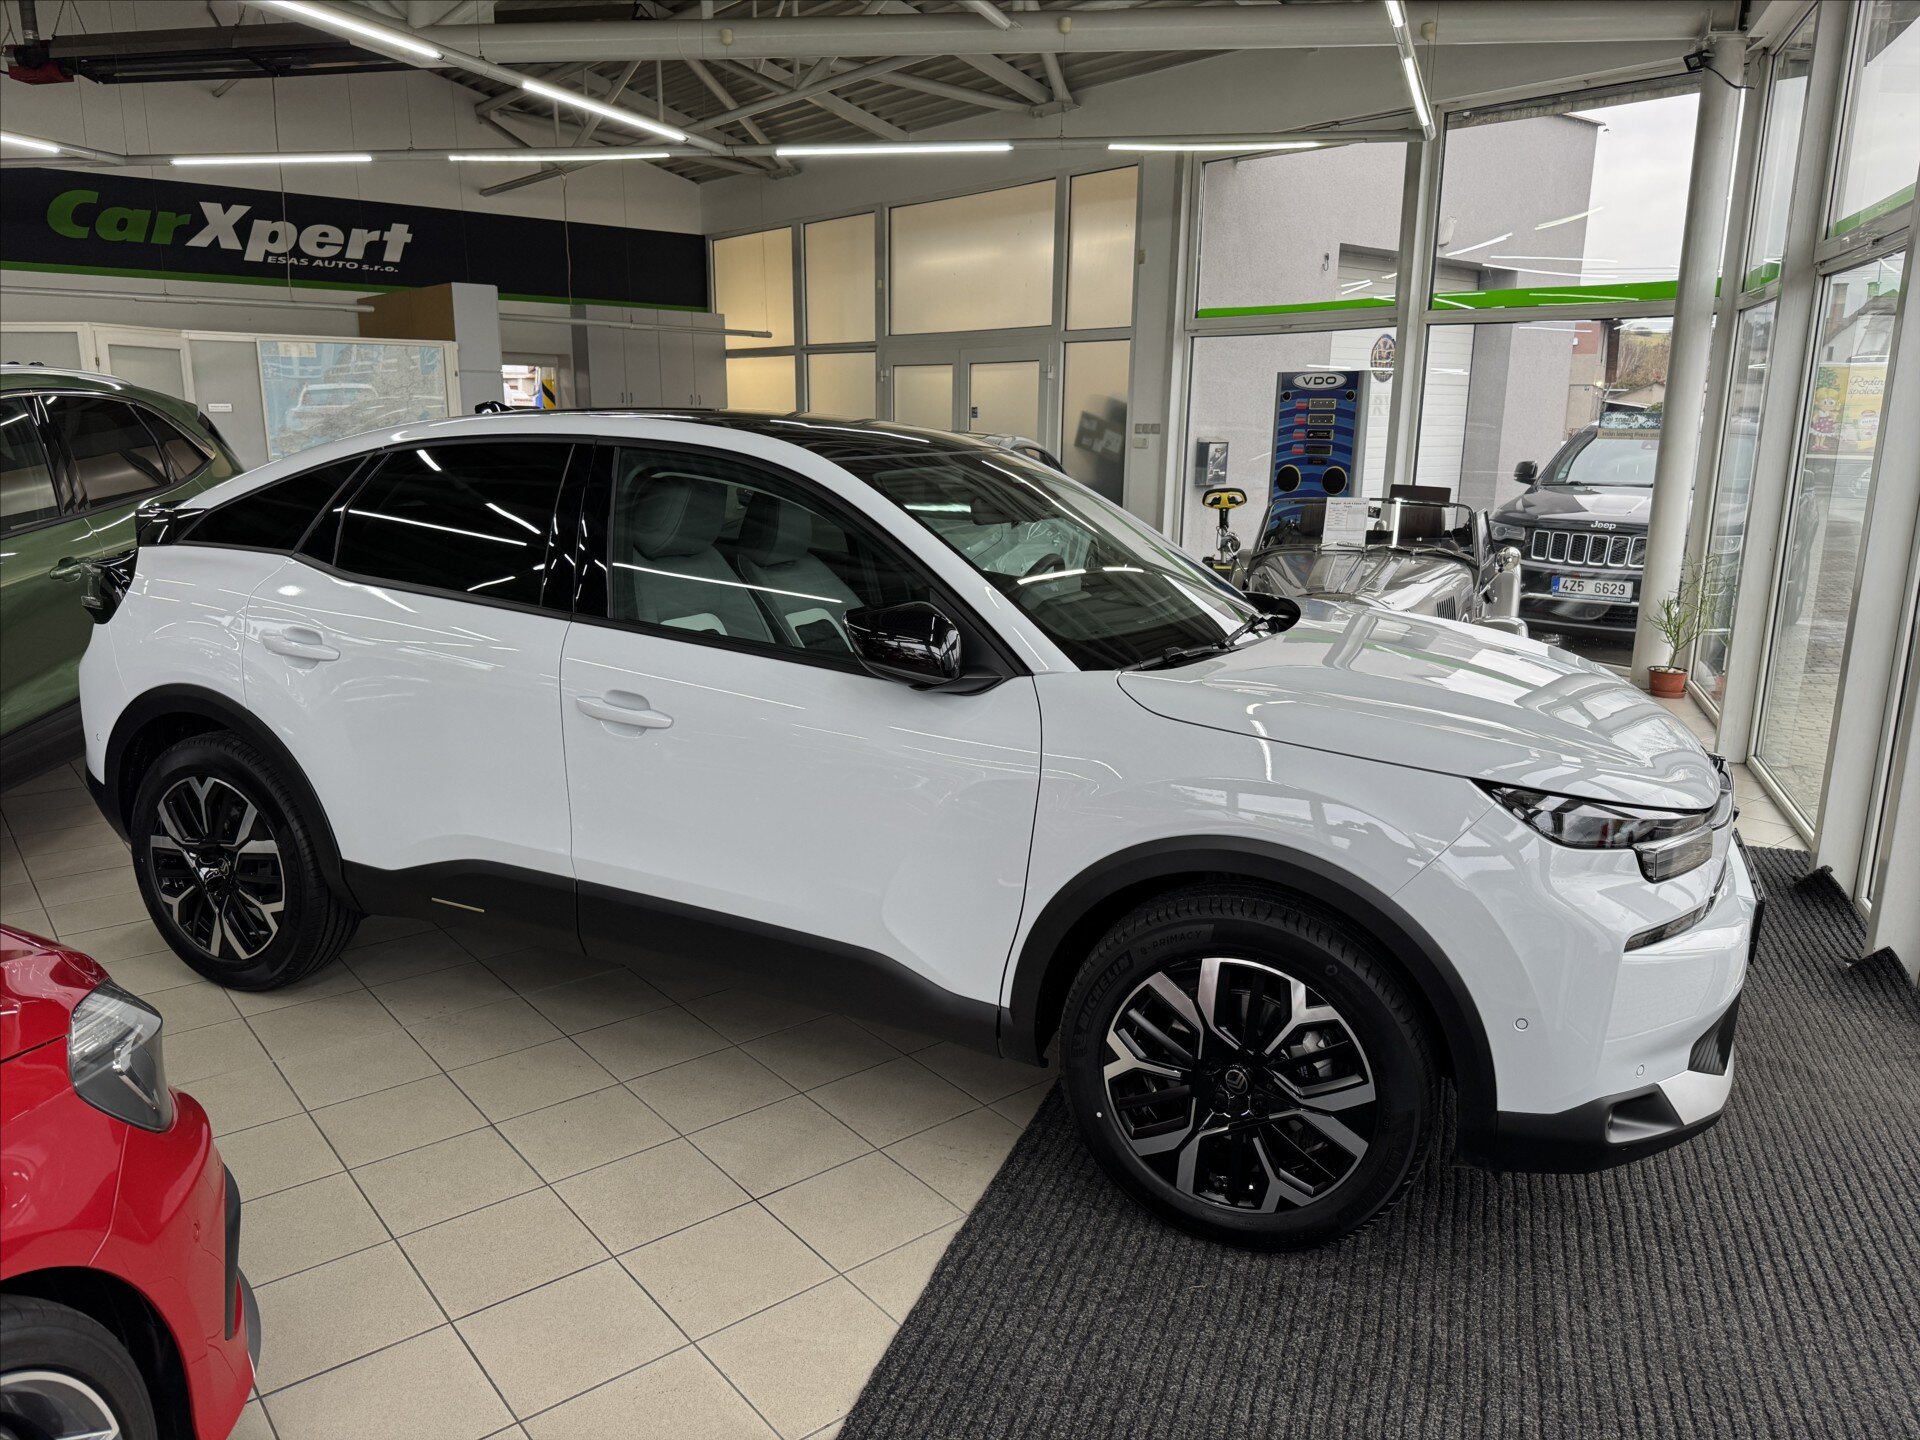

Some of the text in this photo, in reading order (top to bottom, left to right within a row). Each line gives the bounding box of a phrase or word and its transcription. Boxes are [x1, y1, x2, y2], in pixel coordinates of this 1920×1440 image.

[46, 189, 413, 263] CarXpert
[266, 255, 399, 273] ESAS AUTO s.r.o.
[1302, 376, 1337, 386] VDO
[1590, 520, 1617, 531] Jeep
[1562, 580, 1626, 596] 4Z5 6629
